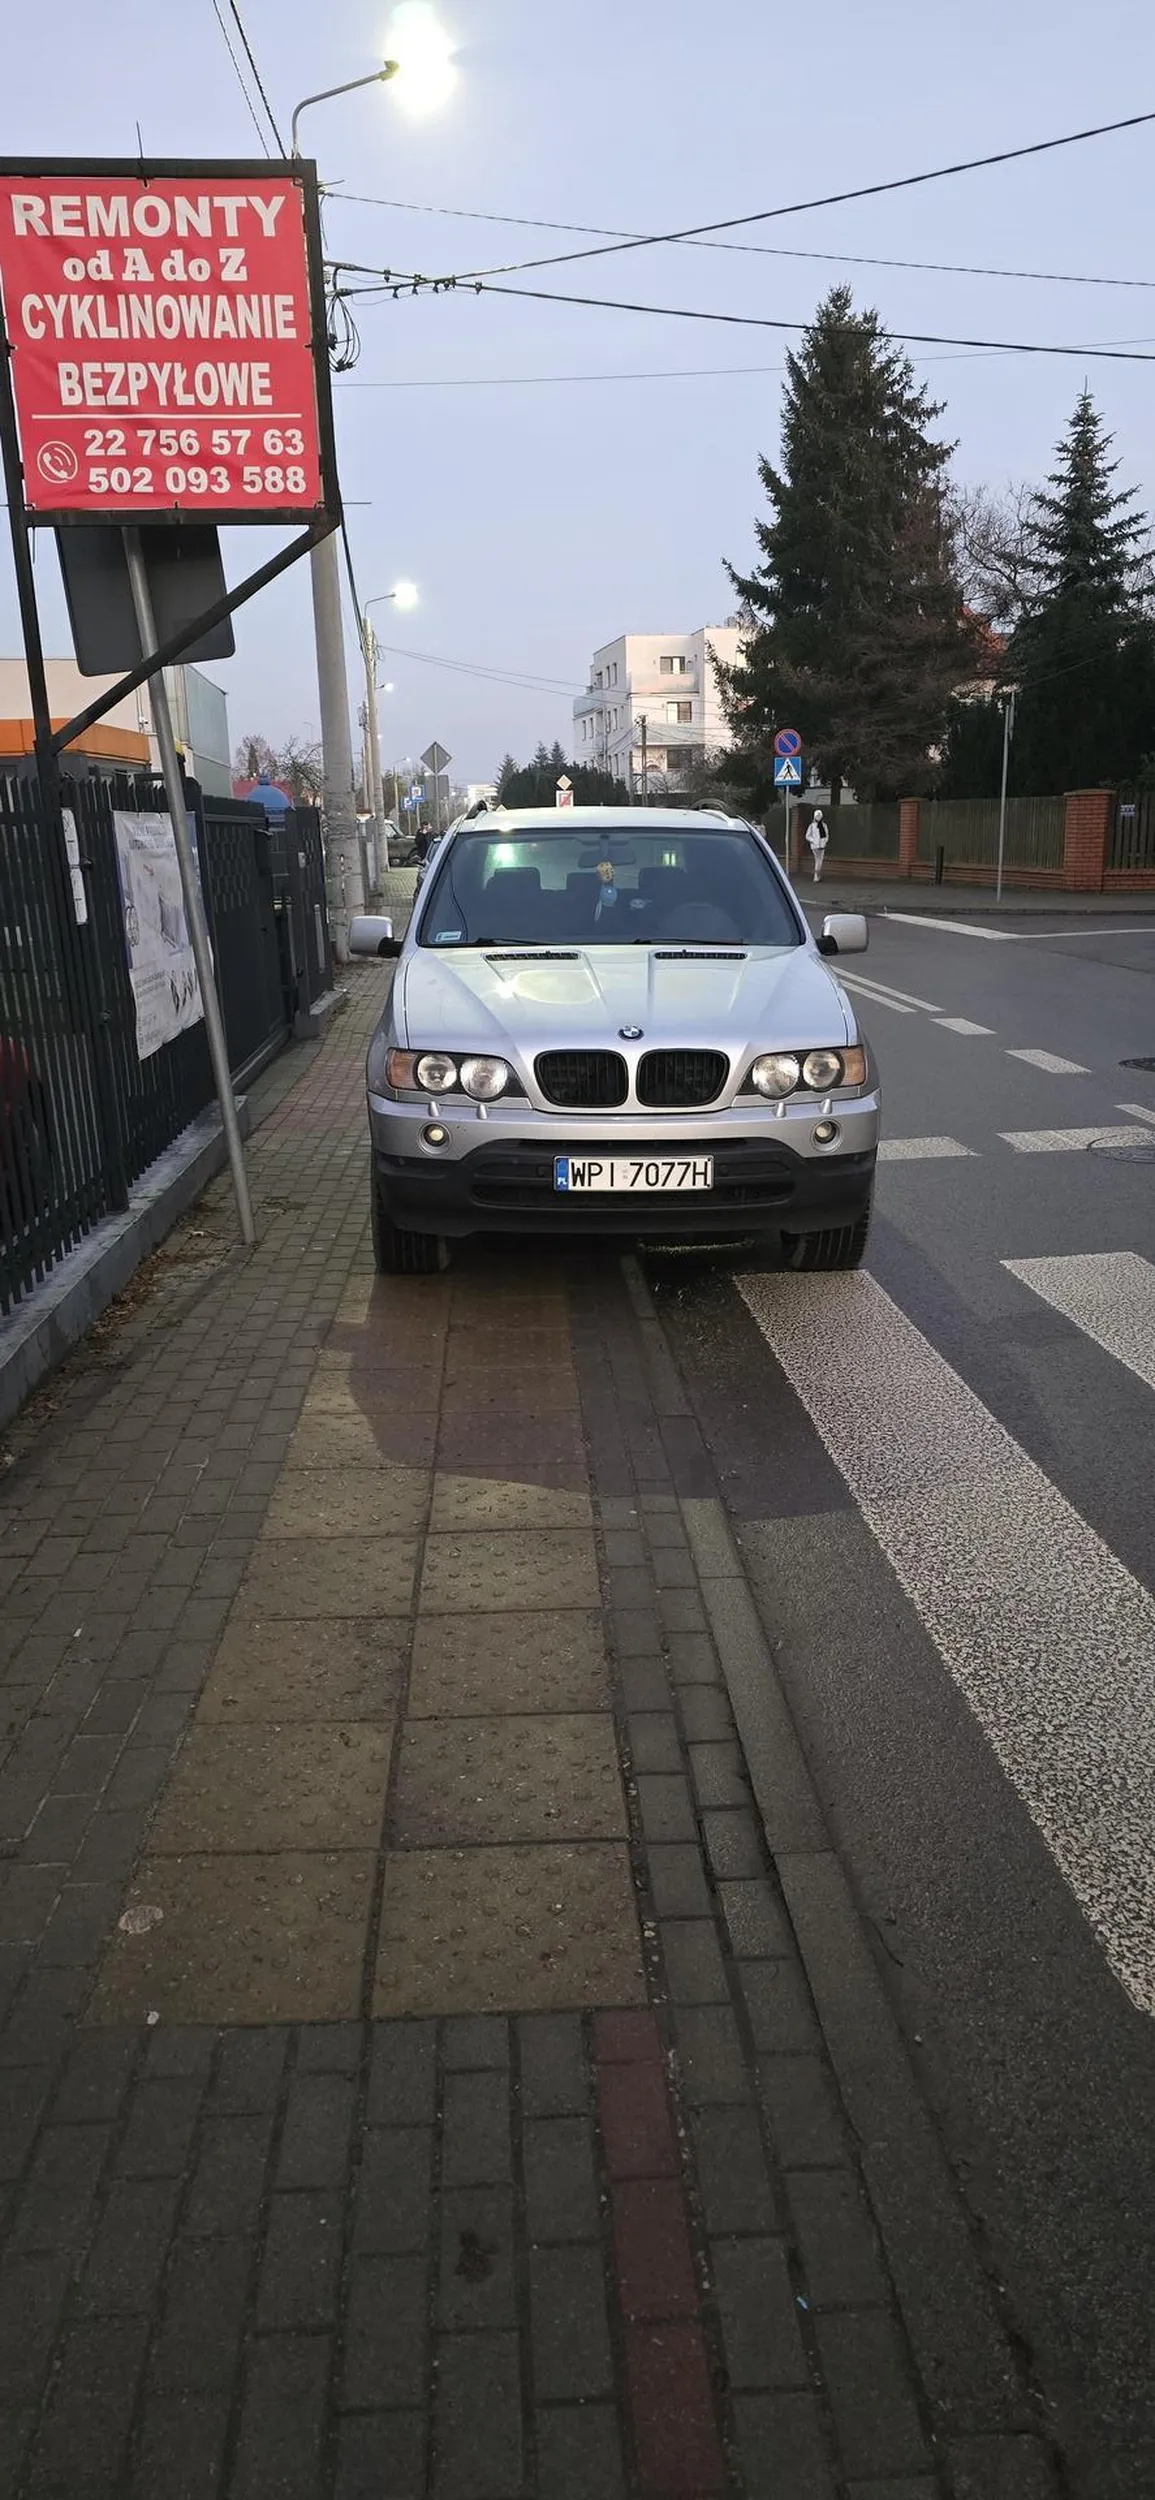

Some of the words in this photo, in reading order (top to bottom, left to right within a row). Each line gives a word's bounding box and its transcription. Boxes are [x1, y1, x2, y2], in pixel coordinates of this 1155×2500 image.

[10, 194, 286, 238] REMONTY
[62, 249, 114, 282] od
[122, 248, 154, 282] A
[161, 249, 211, 282] do
[219, 248, 248, 282] Z
[21, 293, 297, 339] CYKLINOWANIE
[58, 362, 273, 406] BEZPYŁOWE
[83, 429, 127, 456] 22
[137, 429, 200, 456] 756
[211, 429, 251, 456] 57
[263, 429, 305, 456] 63
[88, 467, 154, 494] 502
[165, 466, 231, 494] 093
[242, 466, 307, 494] 588
[557, 1177, 567, 1185] PL
[571, 1162, 614, 1187] WPI
[629, 1161, 708, 1187] 7077H
